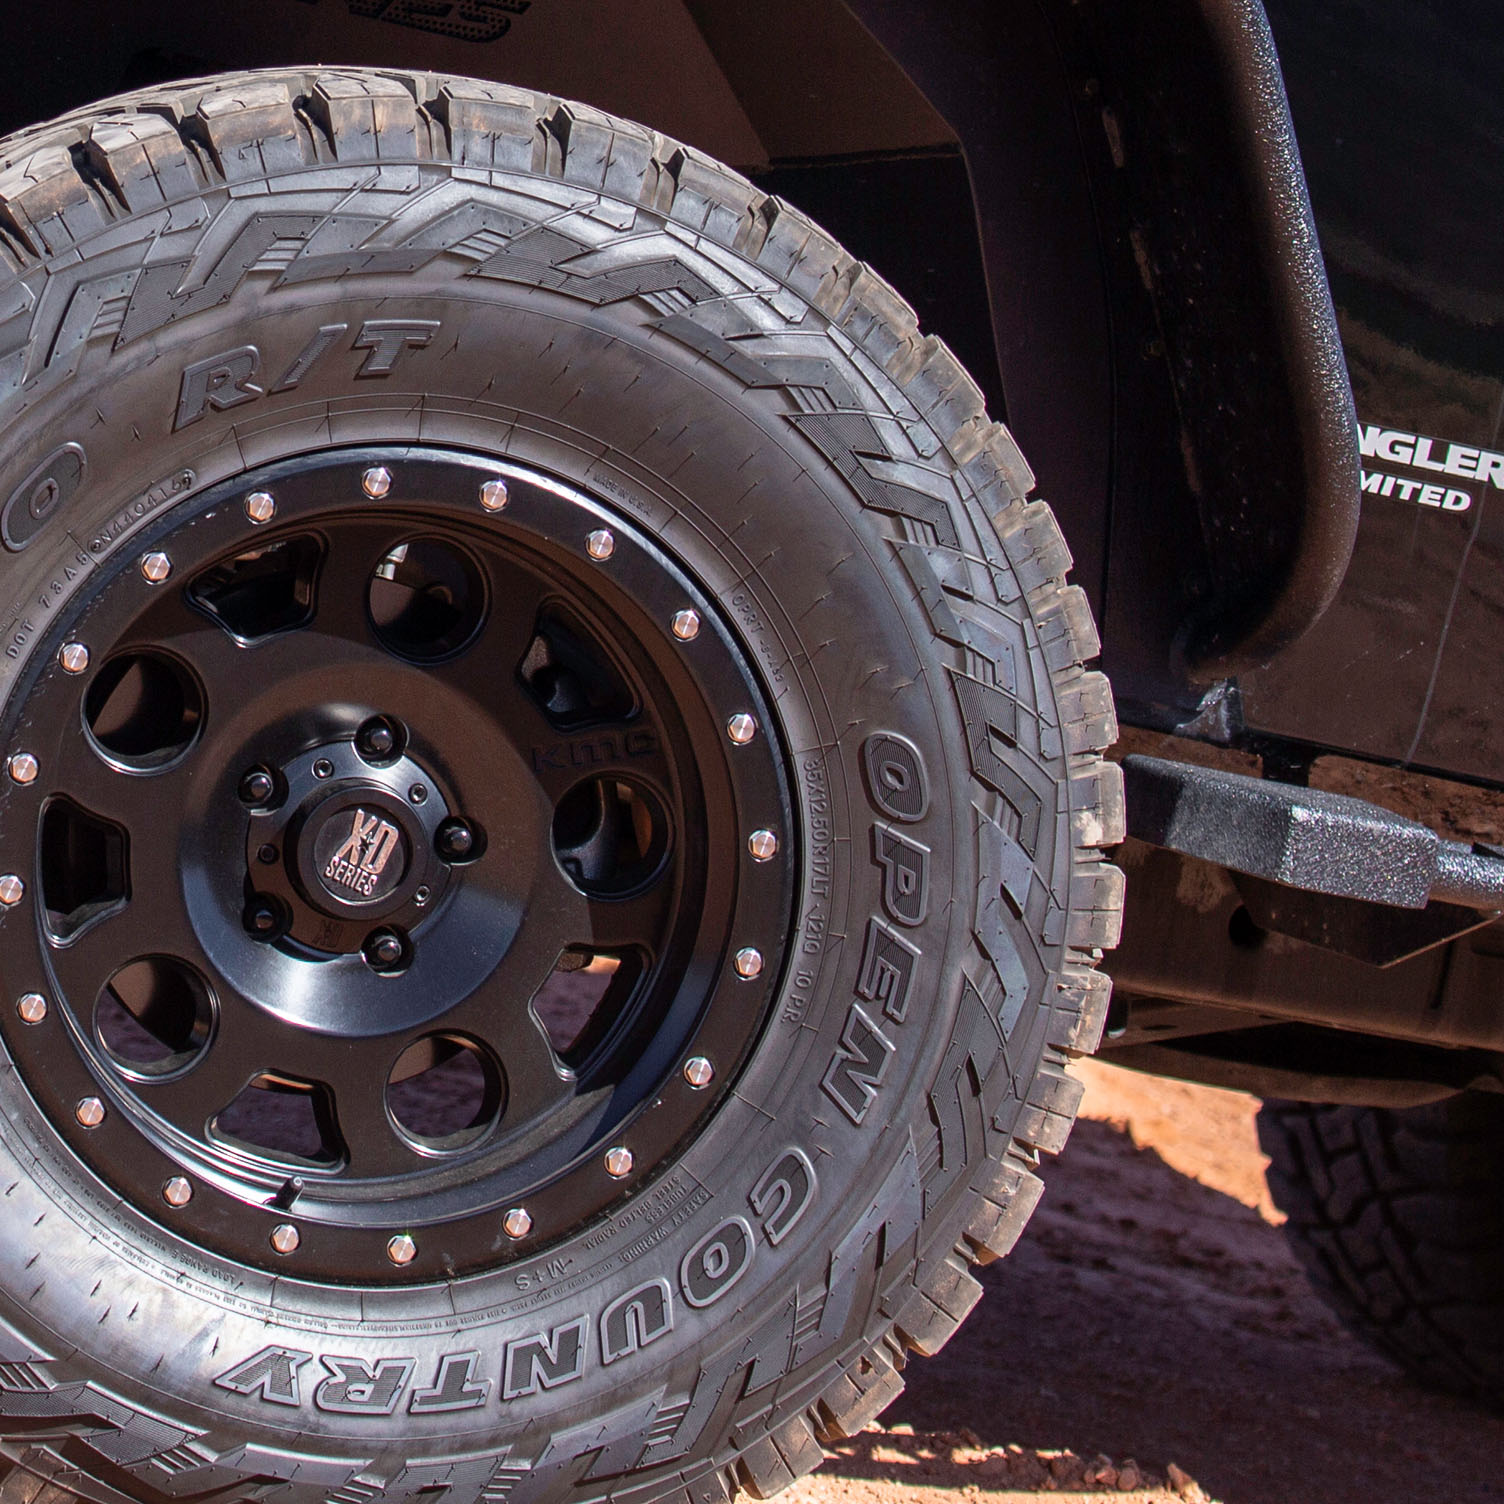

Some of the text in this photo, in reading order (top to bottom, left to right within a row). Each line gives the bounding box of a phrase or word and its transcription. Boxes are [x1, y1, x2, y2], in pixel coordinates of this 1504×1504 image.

[5, 618, 36, 660] DOT
[324, 855, 378, 897] SERIES
[818, 731, 932, 1127] OPEN
[795, 969, 815, 990] 10
[214, 1145, 819, 1416] COUNTRY
